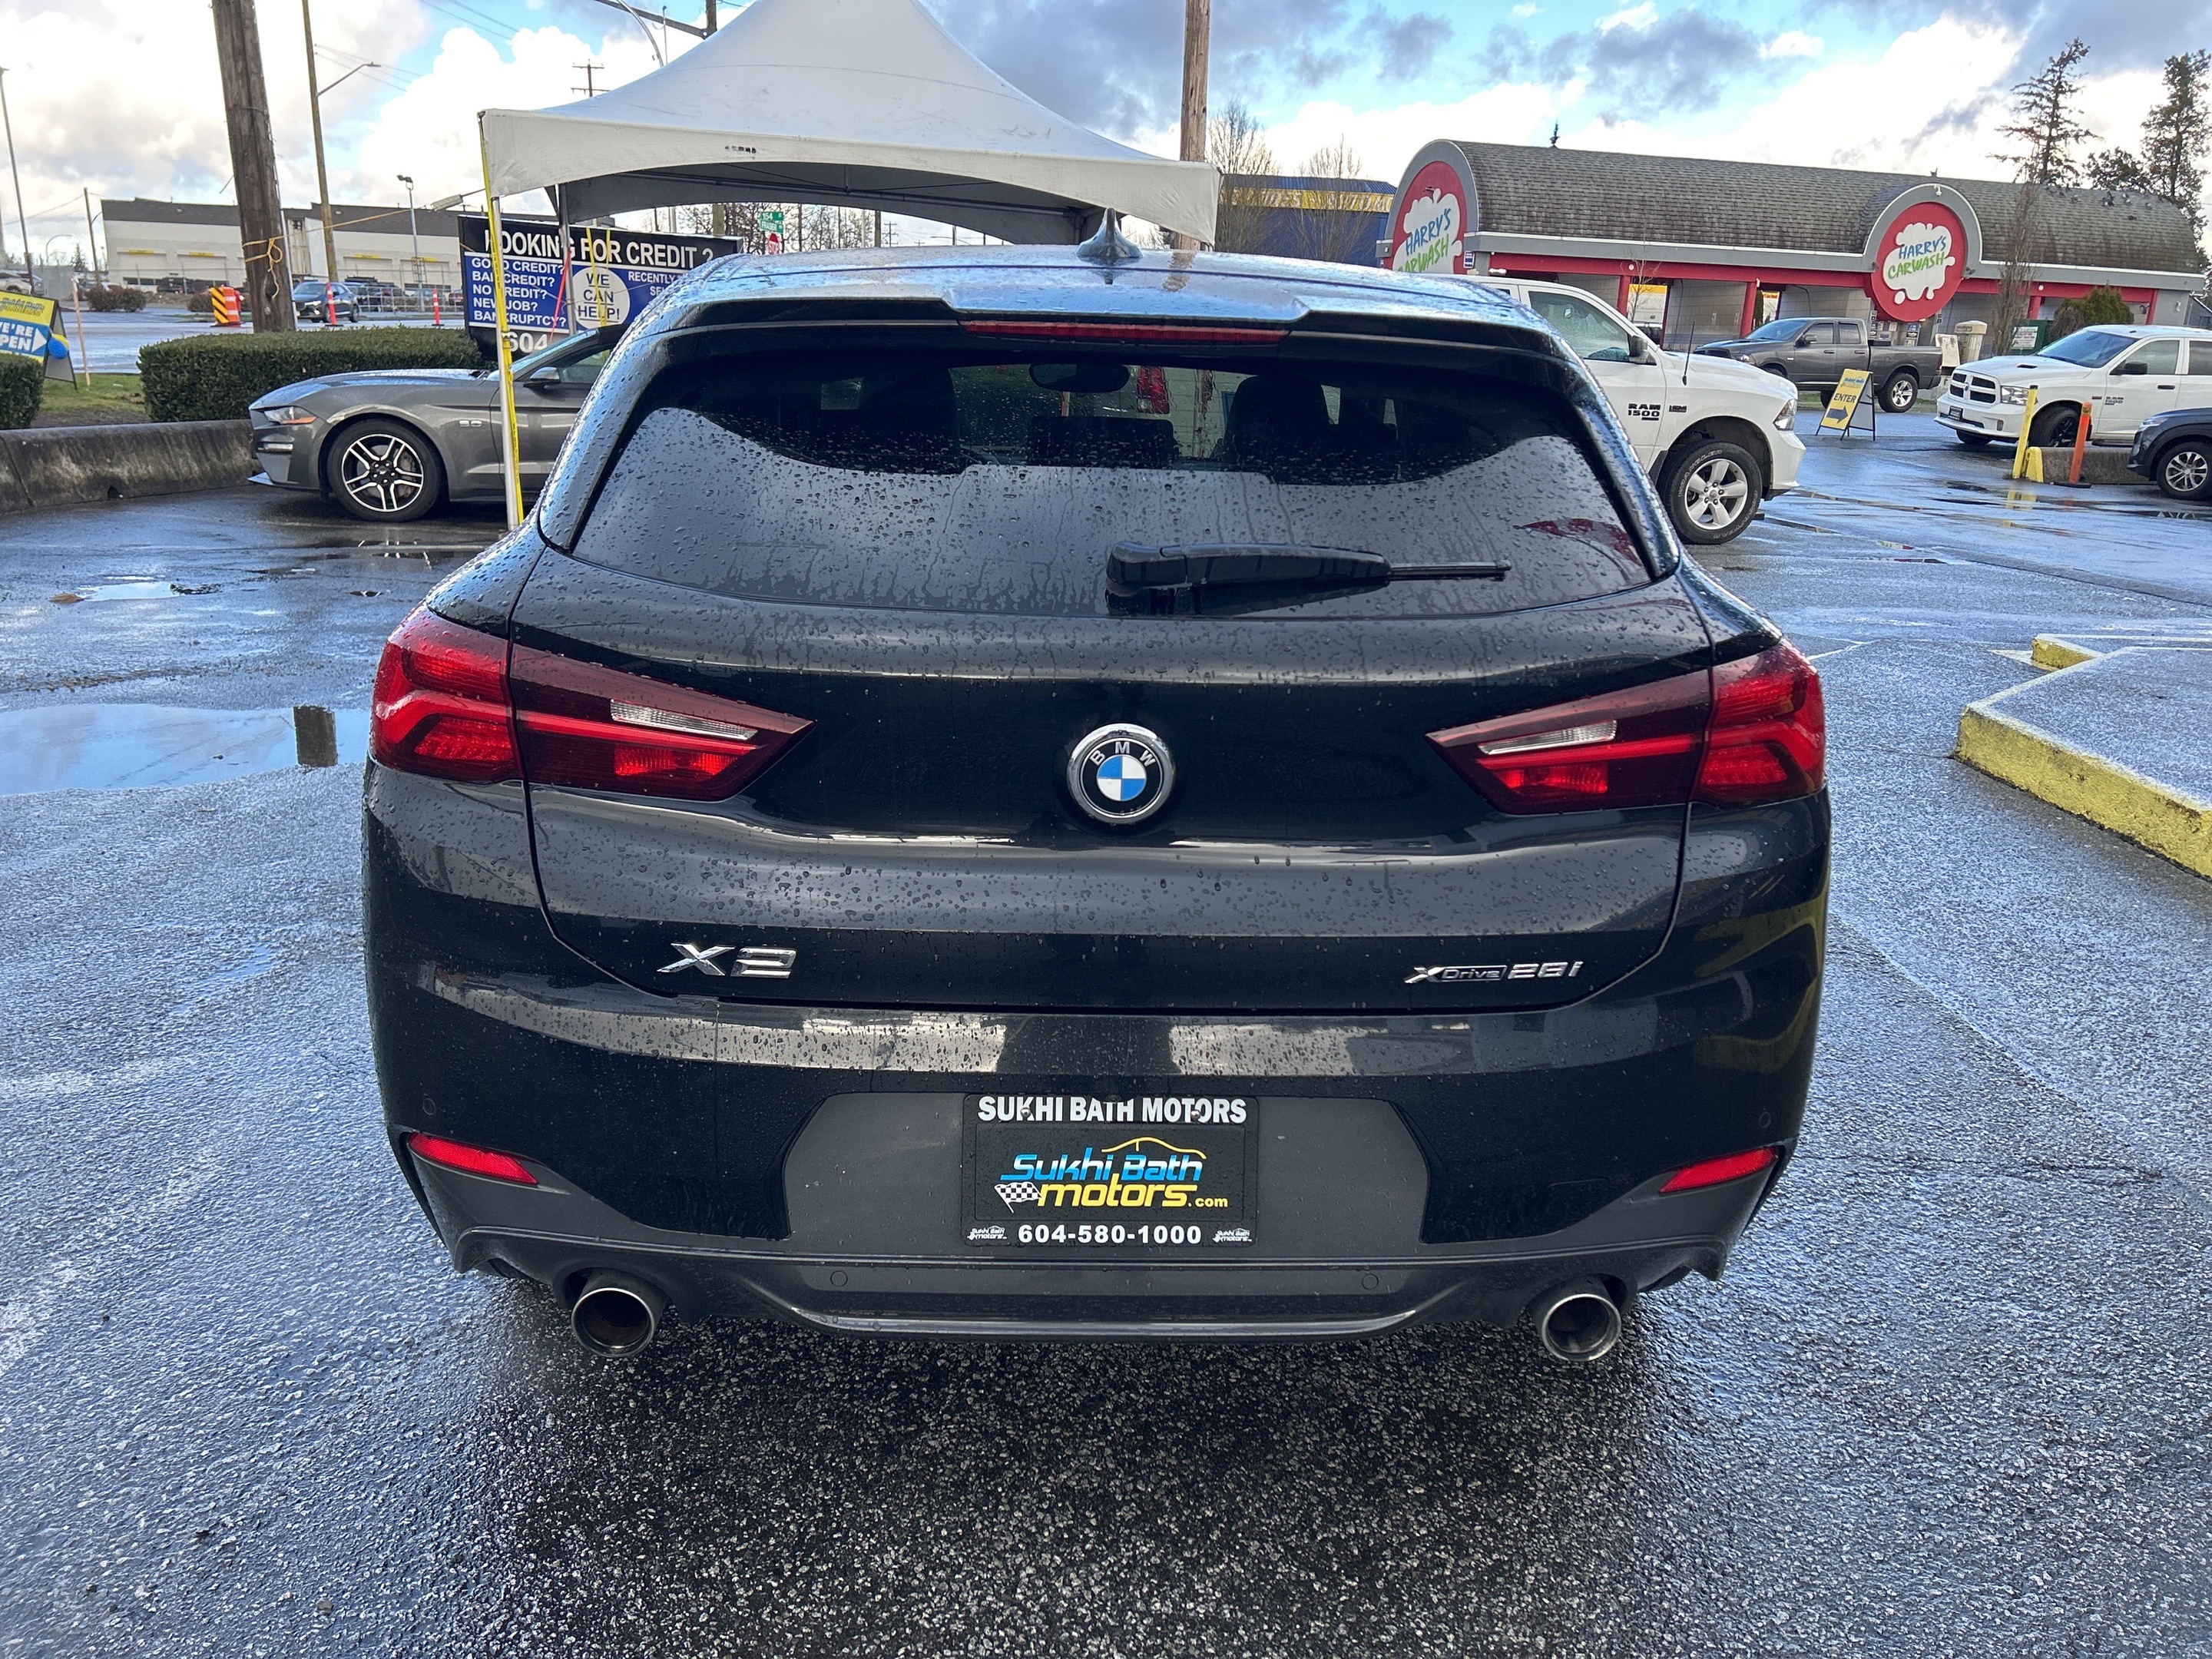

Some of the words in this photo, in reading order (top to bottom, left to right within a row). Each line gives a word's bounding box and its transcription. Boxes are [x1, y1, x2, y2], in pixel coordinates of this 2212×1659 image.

[1406, 208, 1451, 255] HARRY'S
[581, 237, 622, 263] FOR
[626, 241, 697, 269] CREDIT
[1899, 236, 1946, 259] HARRY'S
[472, 257, 509, 270] GOD
[512, 261, 565, 275] CREDIT?
[1888, 252, 1945, 279] CARWASH
[504, 274, 555, 287] CREDIT?
[586, 273, 610, 286] WE
[628, 271, 675, 284] RECENTLY
[473, 284, 492, 295] NO
[505, 286, 547, 300] REDIT?
[584, 290, 614, 303] CAN
[506, 300, 538, 312] JOB?
[578, 306, 620, 320] HELP!
[0, 322, 34, 336] E'RE
[0, 333, 31, 351] PEN
[1833, 393, 1857, 403] ENTER
[1089, 741, 1156, 767] BMW
[657, 942, 796, 979] X2
[1508, 961, 1584, 979] 28i
[978, 1096, 1063, 1122] SUKHI
[1069, 1097, 1134, 1123] BATH
[1142, 1098, 1247, 1124] MOTORS
[1000, 1147, 1111, 1181] Sukhi
[1123, 1154, 1203, 1181] Bath
[1018, 1224, 1202, 1243] 604-580-1000
